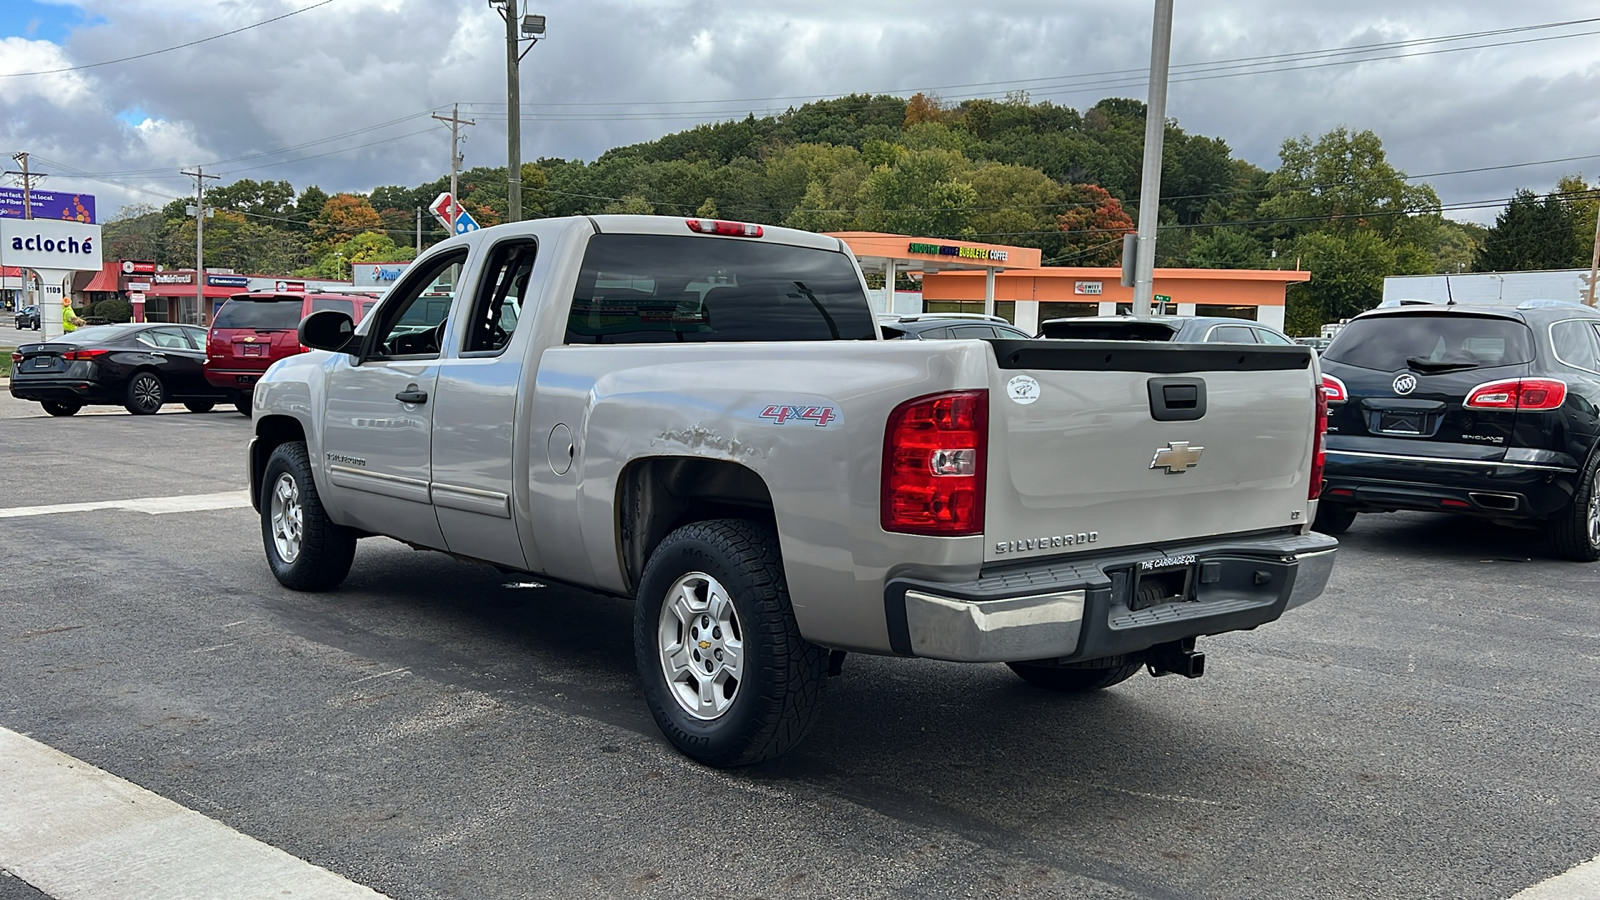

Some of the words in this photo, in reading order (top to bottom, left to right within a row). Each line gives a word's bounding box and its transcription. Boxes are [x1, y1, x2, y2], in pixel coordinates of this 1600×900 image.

[12, 234, 93, 254] acloché
[46, 286, 61, 294] 1109
[995, 531, 1099, 555] SILVERADO
[1141, 560, 1154, 570] THE
[1155, 556, 1186, 568] CARRIAGE
